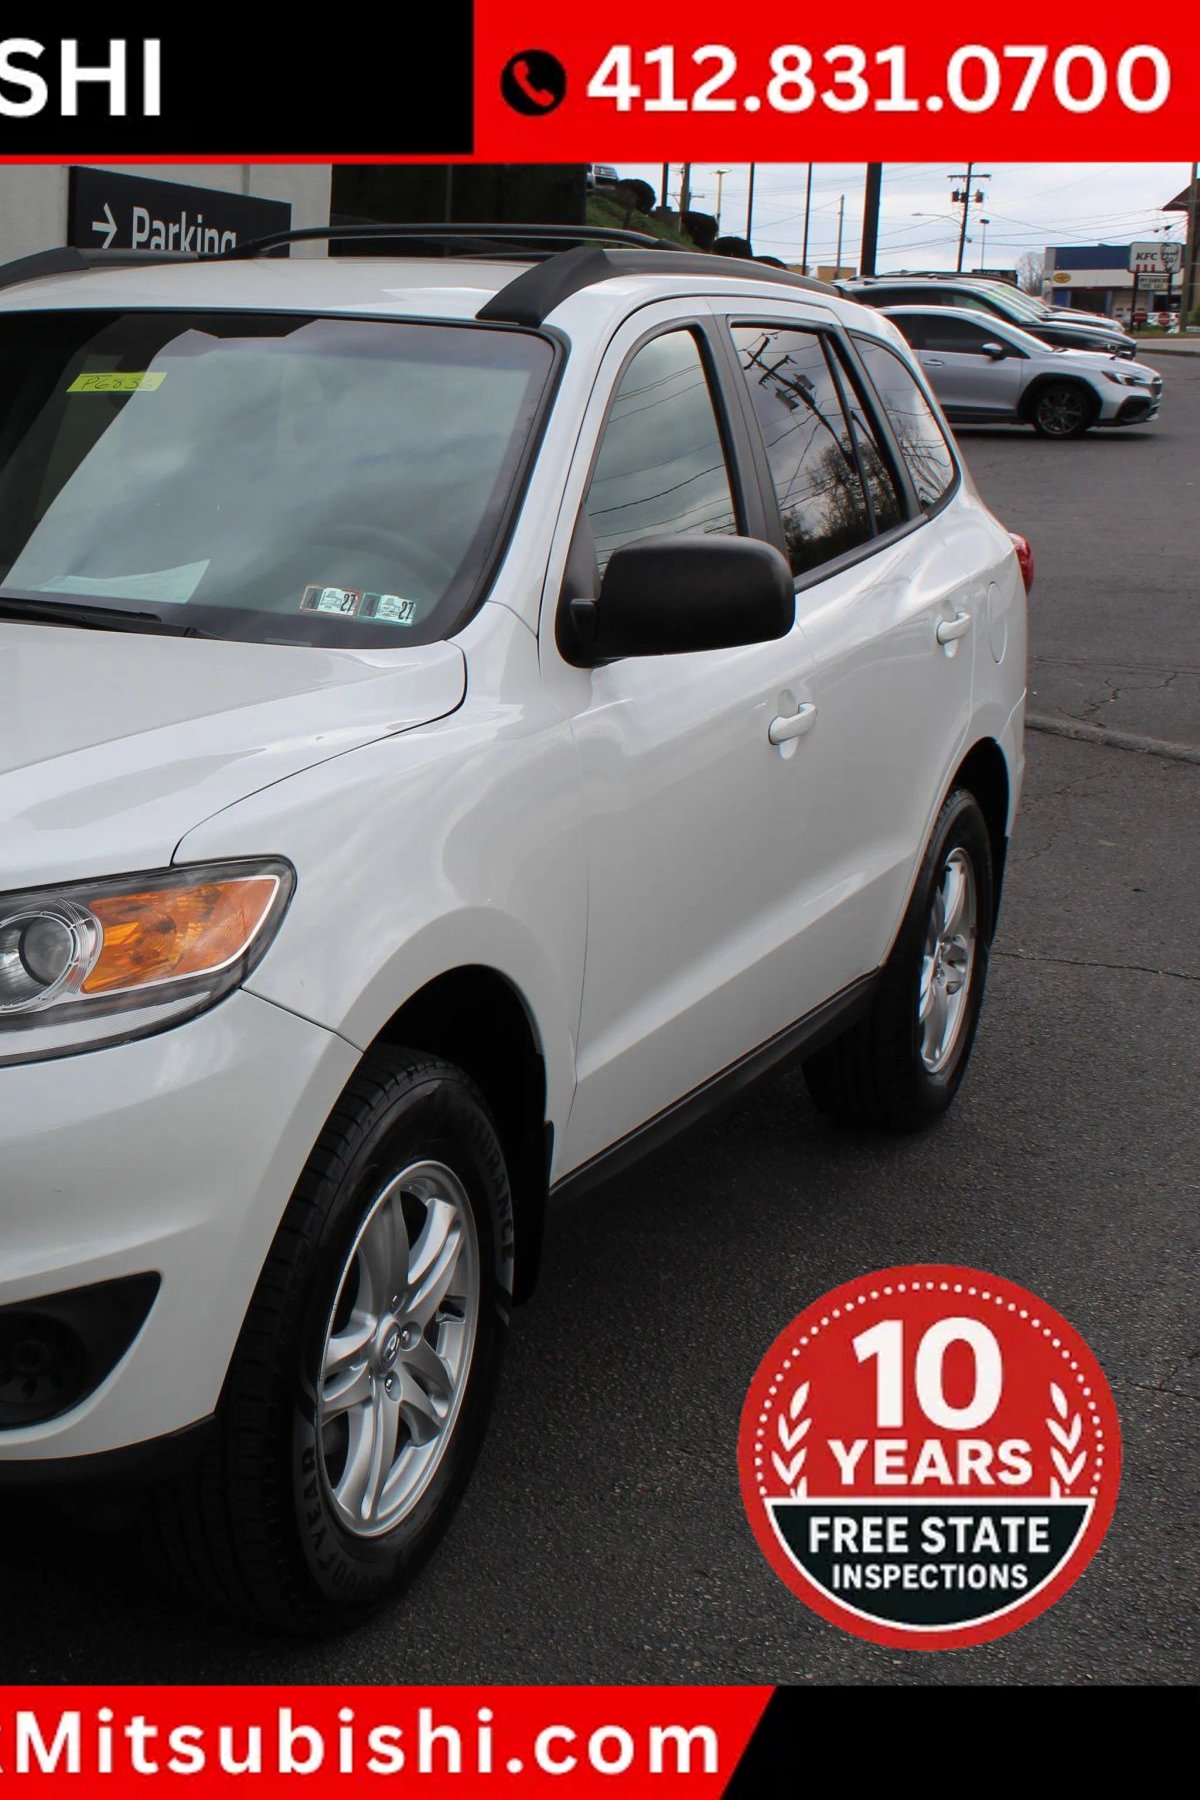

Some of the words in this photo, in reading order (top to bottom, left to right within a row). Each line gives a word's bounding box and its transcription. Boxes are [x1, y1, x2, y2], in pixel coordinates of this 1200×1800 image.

[1135, 252, 1158, 261] KFC
[340, 593, 356, 613] 27
[398, 600, 414, 620] 27
